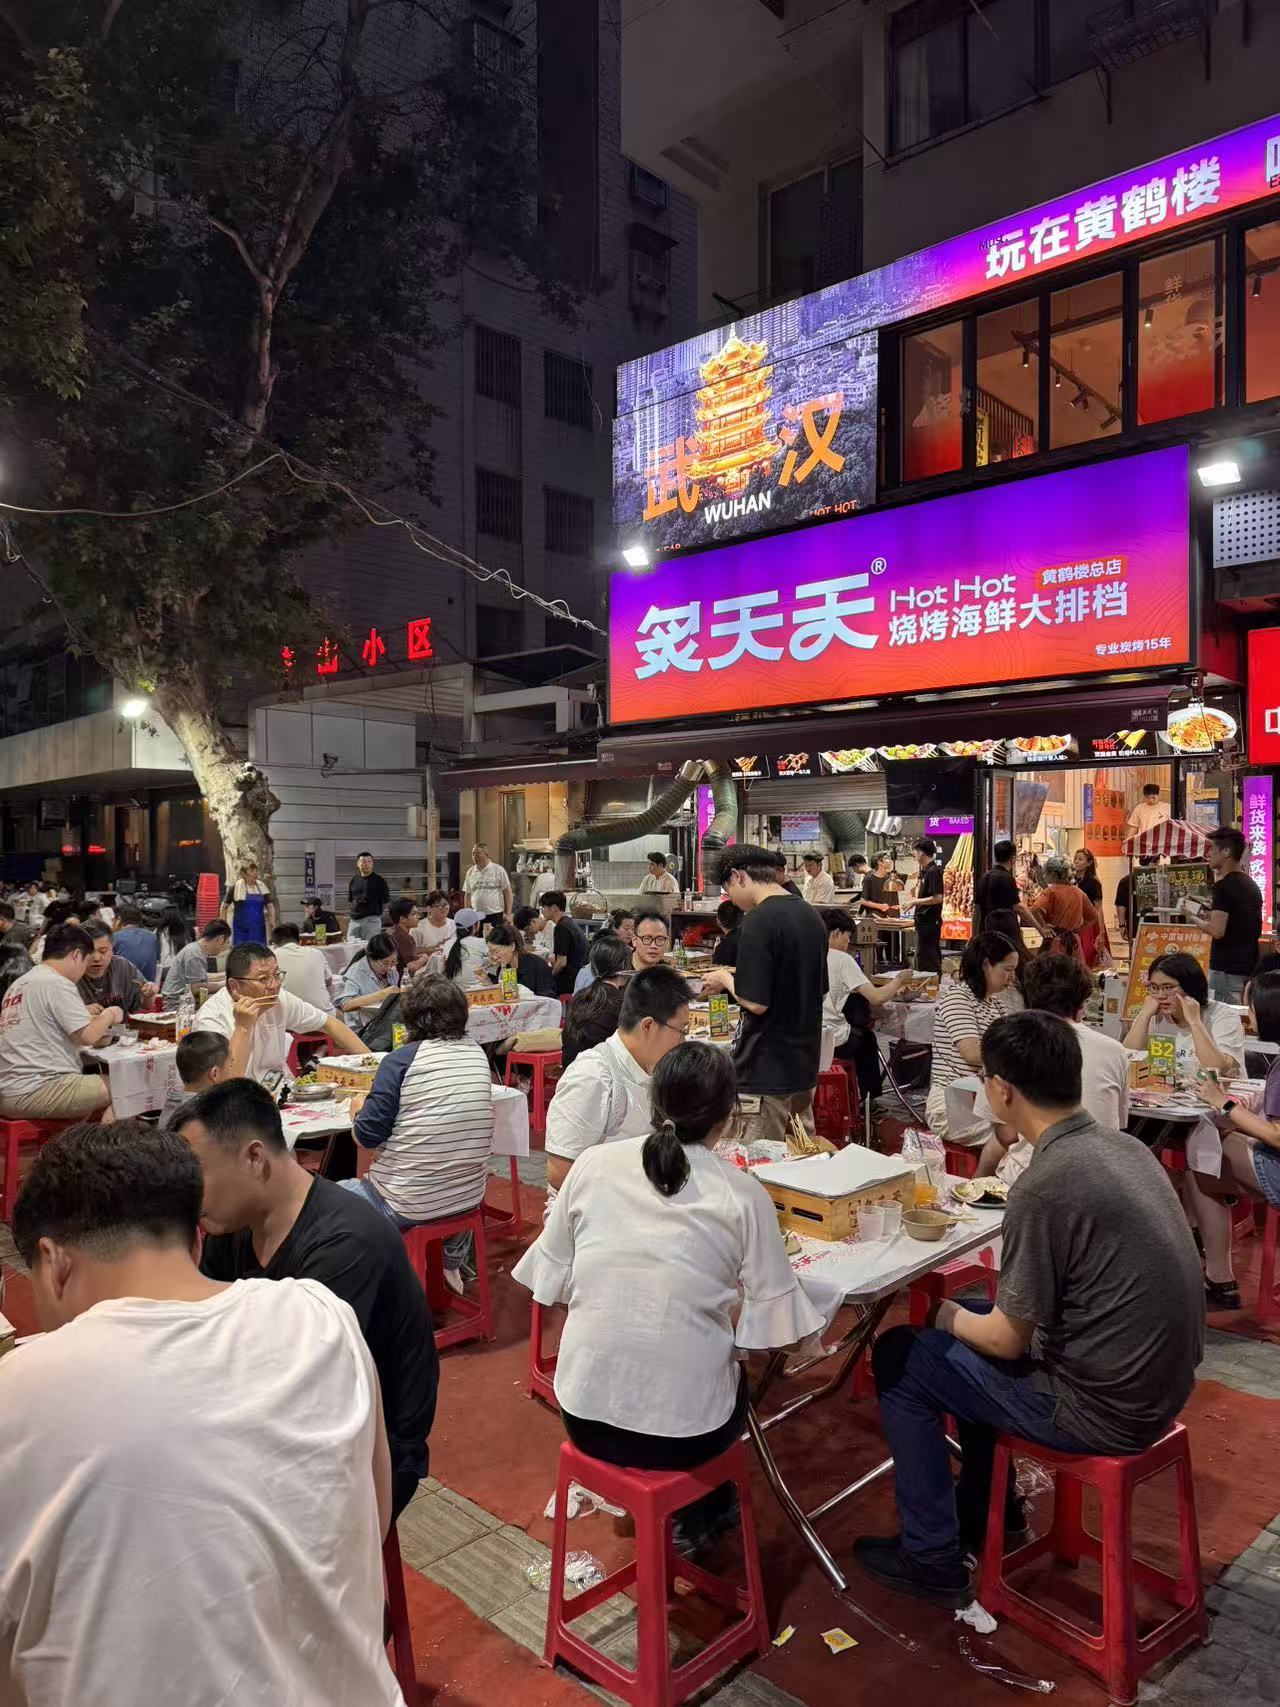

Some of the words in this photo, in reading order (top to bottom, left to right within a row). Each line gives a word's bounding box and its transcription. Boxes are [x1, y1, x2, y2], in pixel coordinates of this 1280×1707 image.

[985, 156, 1221, 280] 玩在黄鹤楼
[704, 491, 771, 524] WUHAN
[834, 499, 858, 513] HOT
[1042, 558, 1122, 586] 黄鹤楼总店
[890, 584, 948, 612] Hot
[954, 573, 1017, 603] Hot
[634, 572, 879, 680] 炙天天
[888, 581, 1128, 647] 烧烤海鲜大排档
[280, 616, 434, 681] 山小区
[1095, 636, 1172, 656] 专业炭烤15年
[710, 999, 727, 1012] B6
[1151, 1041, 1175, 1058] B2
